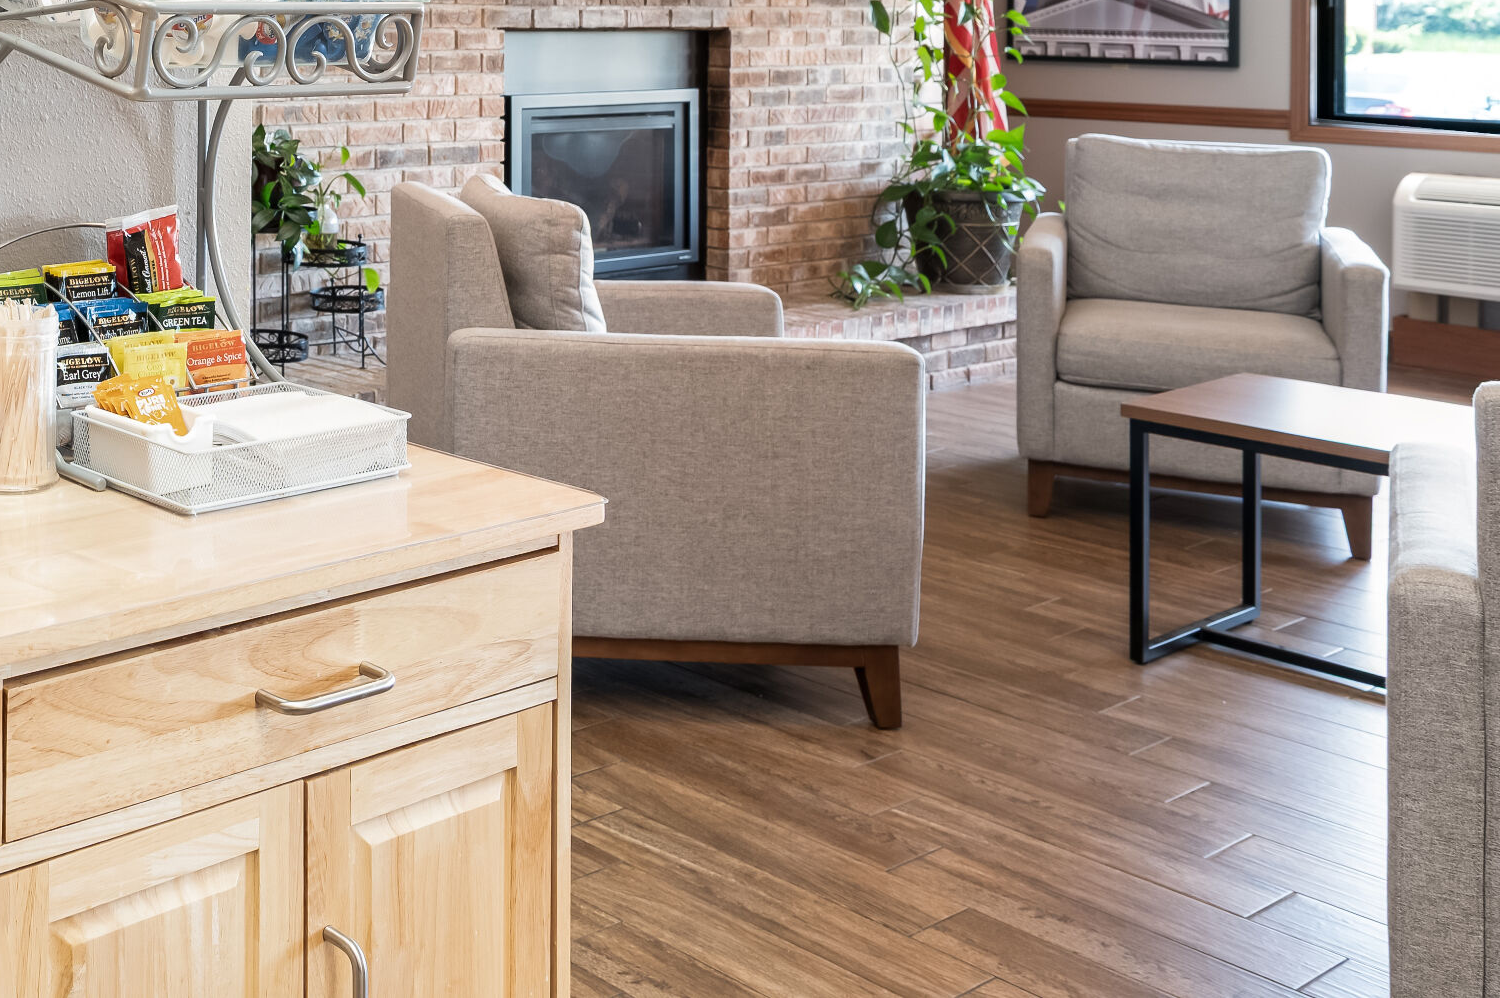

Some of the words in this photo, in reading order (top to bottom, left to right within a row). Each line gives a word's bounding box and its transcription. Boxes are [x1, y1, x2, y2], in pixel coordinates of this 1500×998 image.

[70, 275, 109, 286] BIGELOW
[72, 289, 97, 299] Lemon
[167, 304, 206, 314] BIGELOW
[98, 315, 130, 324] BIGELO
[162, 317, 190, 328] GREEN
[191, 316, 207, 325] TEA
[192, 340, 236, 352] BIGELOW
[186, 357, 216, 368] Orange
[216, 354, 222, 363] &
[224, 352, 242, 364] Spice
[63, 370, 80, 380] Earl
[82, 370, 101, 382] Grey
